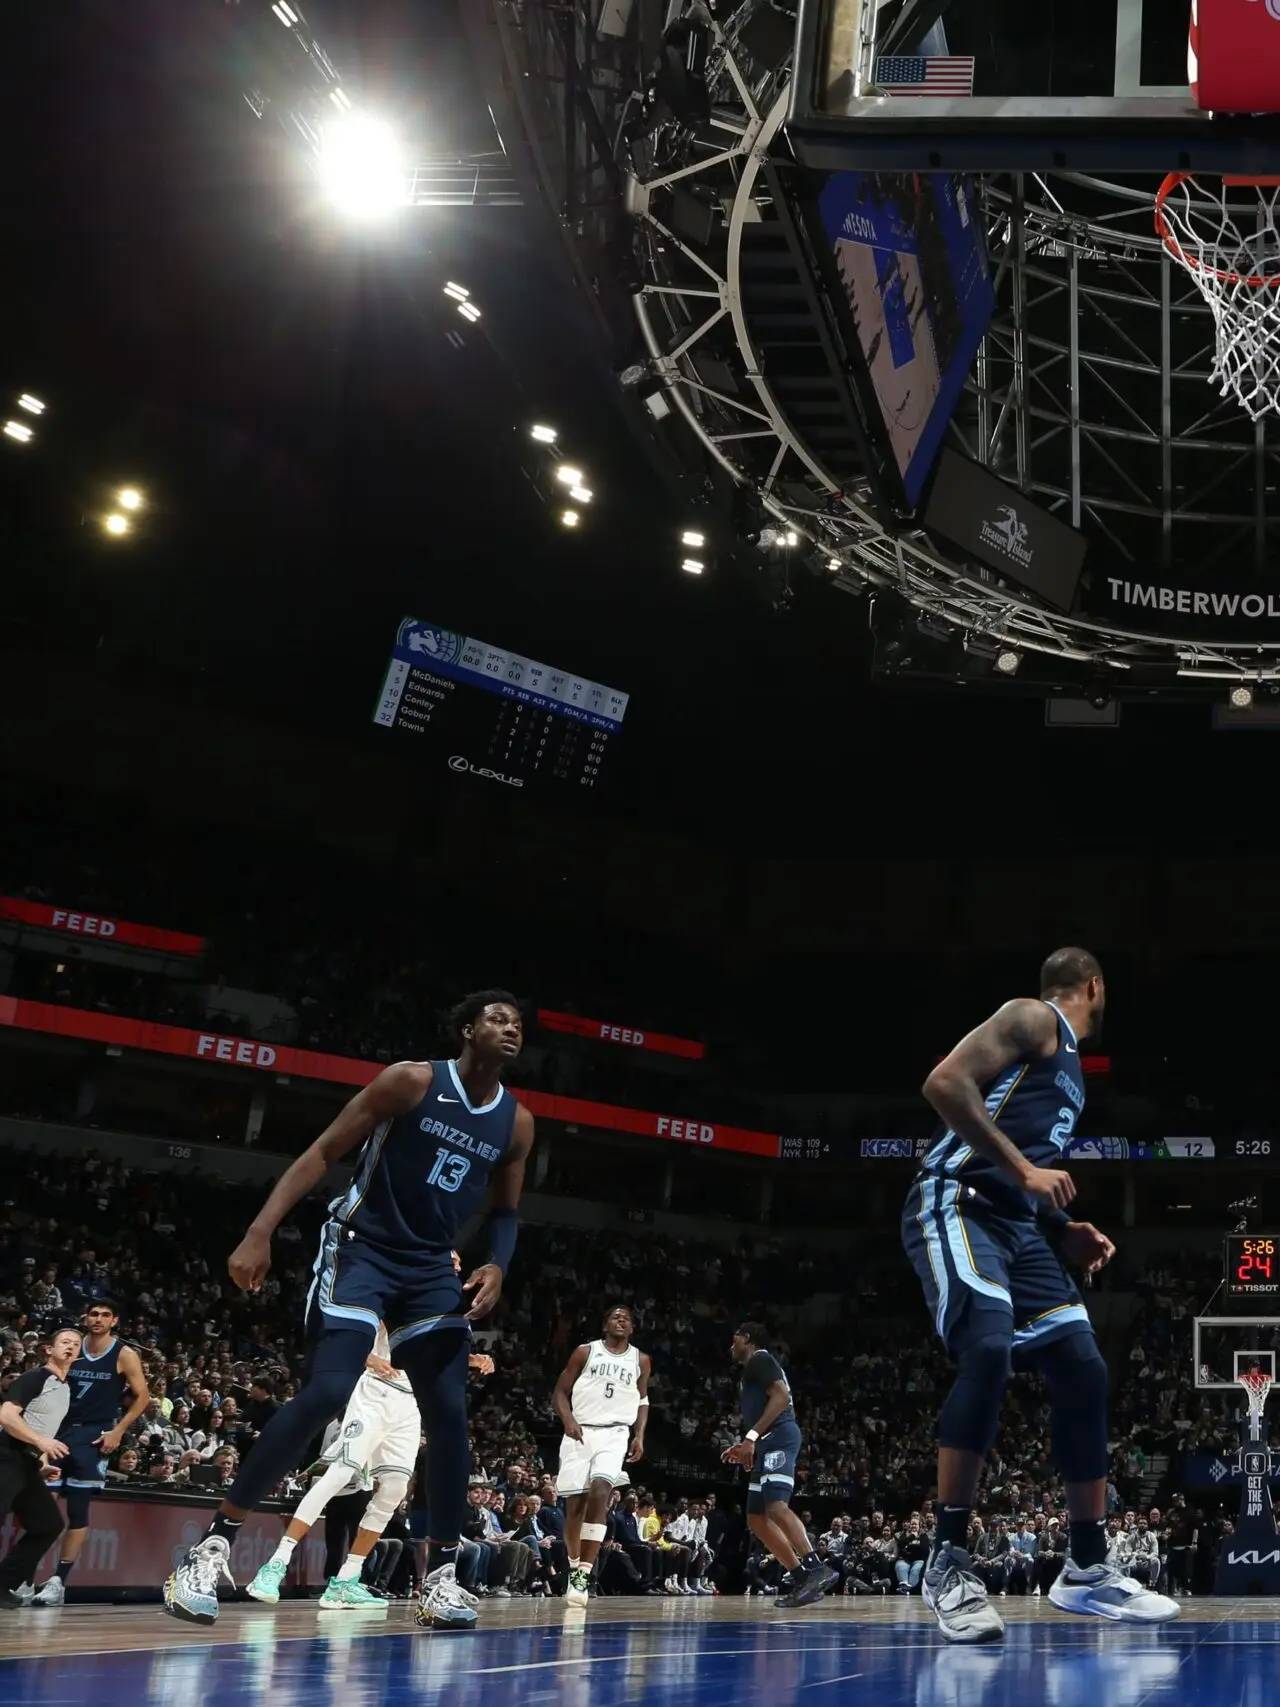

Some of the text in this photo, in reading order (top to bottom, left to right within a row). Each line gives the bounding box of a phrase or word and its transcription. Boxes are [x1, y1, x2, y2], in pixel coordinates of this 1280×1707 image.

[411, 669, 456, 690] McDaniels
[408, 681, 446, 700] Edwards
[404, 693, 436, 711] Conley
[400, 705, 431, 721] Gobert
[397, 717, 425, 733] Towns
[470, 763, 524, 787] LEXUS
[52, 910, 116, 936] FEED
[600, 1024, 644, 1045] FEED
[197, 1035, 277, 1067] FEED
[656, 1116, 714, 1143] FEED
[1049, 1106, 1075, 1152] 2
[419, 1117, 501, 1162] GRIZZLIES
[783, 1138, 821, 1148] WAS 109
[860, 1138, 912, 1157] KFAN
[1184, 1142, 1204, 1156] 12
[1235, 1140, 1271, 1155] 5:26
[783, 1149, 820, 1159] NYK 113
[426, 1147, 471, 1192] 13
[1243, 1240, 1274, 1254] 5:26
[1237, 1255, 1272, 1280] 24
[1244, 1284, 1279, 1292] TISSOT
[590, 1362, 633, 1386] WOLVES
[76, 1380, 94, 1399] 7
[604, 1382, 615, 1399] 5
[1247, 1475, 1263, 1489] GET
[1247, 1489, 1263, 1503] THE
[1246, 1503, 1263, 1517] APP
